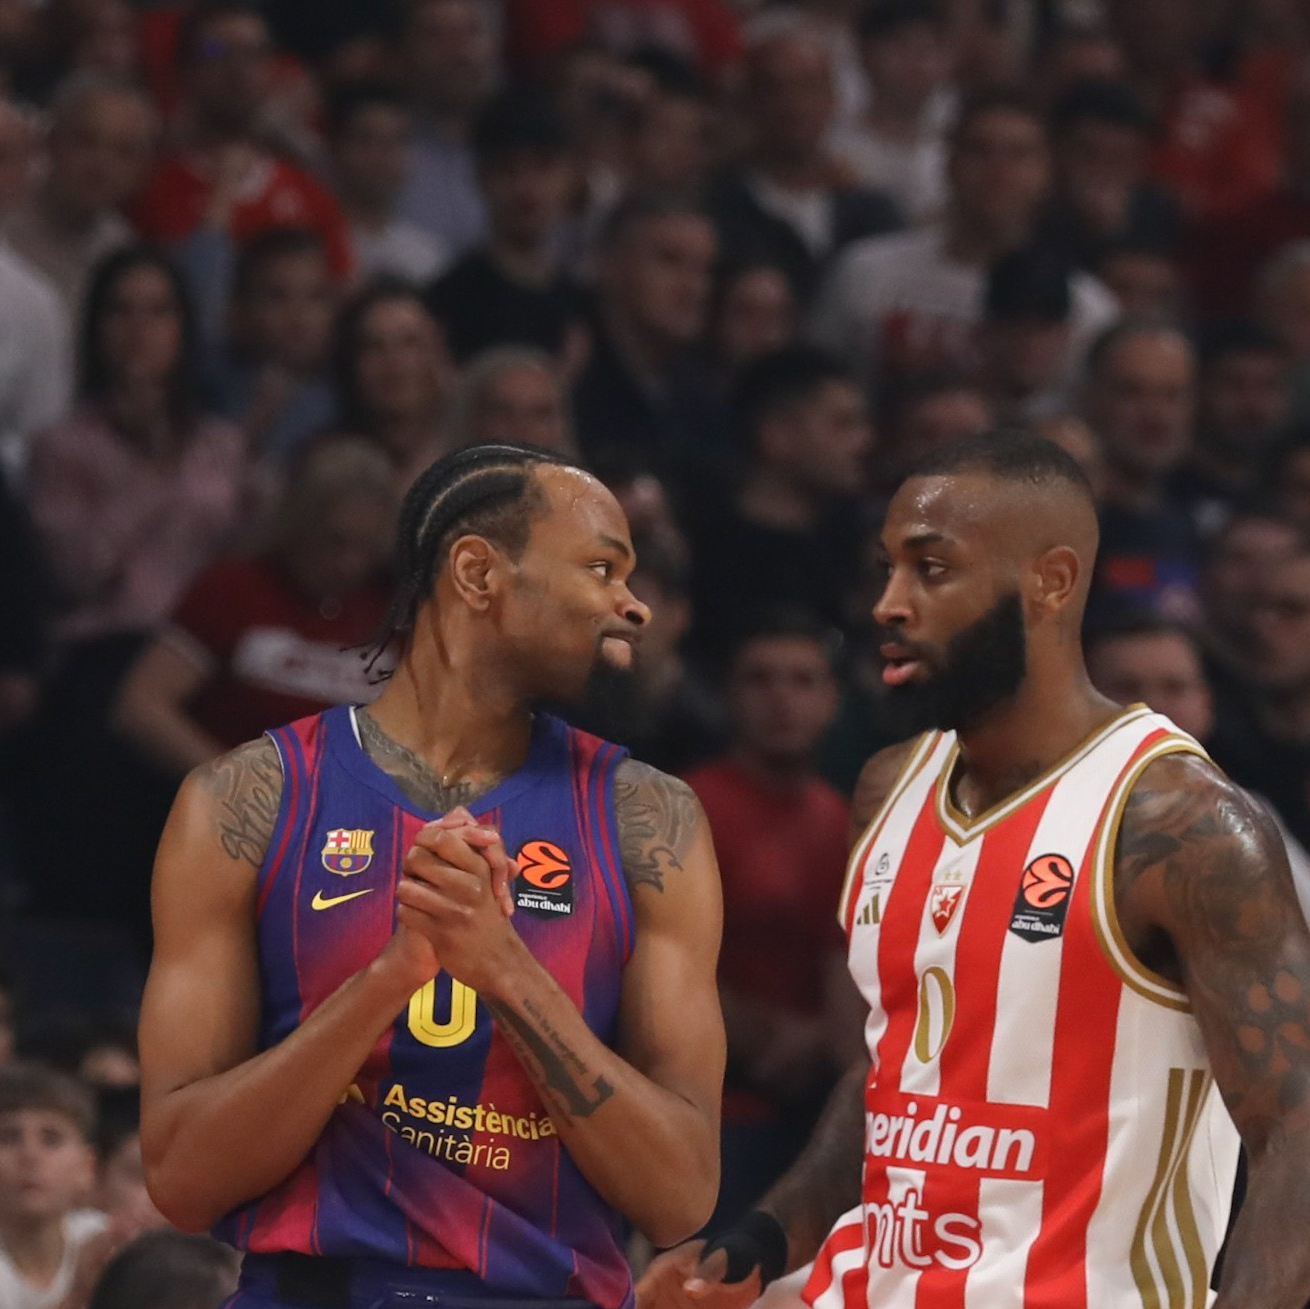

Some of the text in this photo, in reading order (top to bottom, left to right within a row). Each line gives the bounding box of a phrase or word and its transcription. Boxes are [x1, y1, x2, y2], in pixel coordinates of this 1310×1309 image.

[517, 897, 571, 914] abu dhabi
[914, 966, 955, 1064] 0
[381, 1111, 511, 1170] Sanitària
[383, 1083, 558, 1141] Assistència
